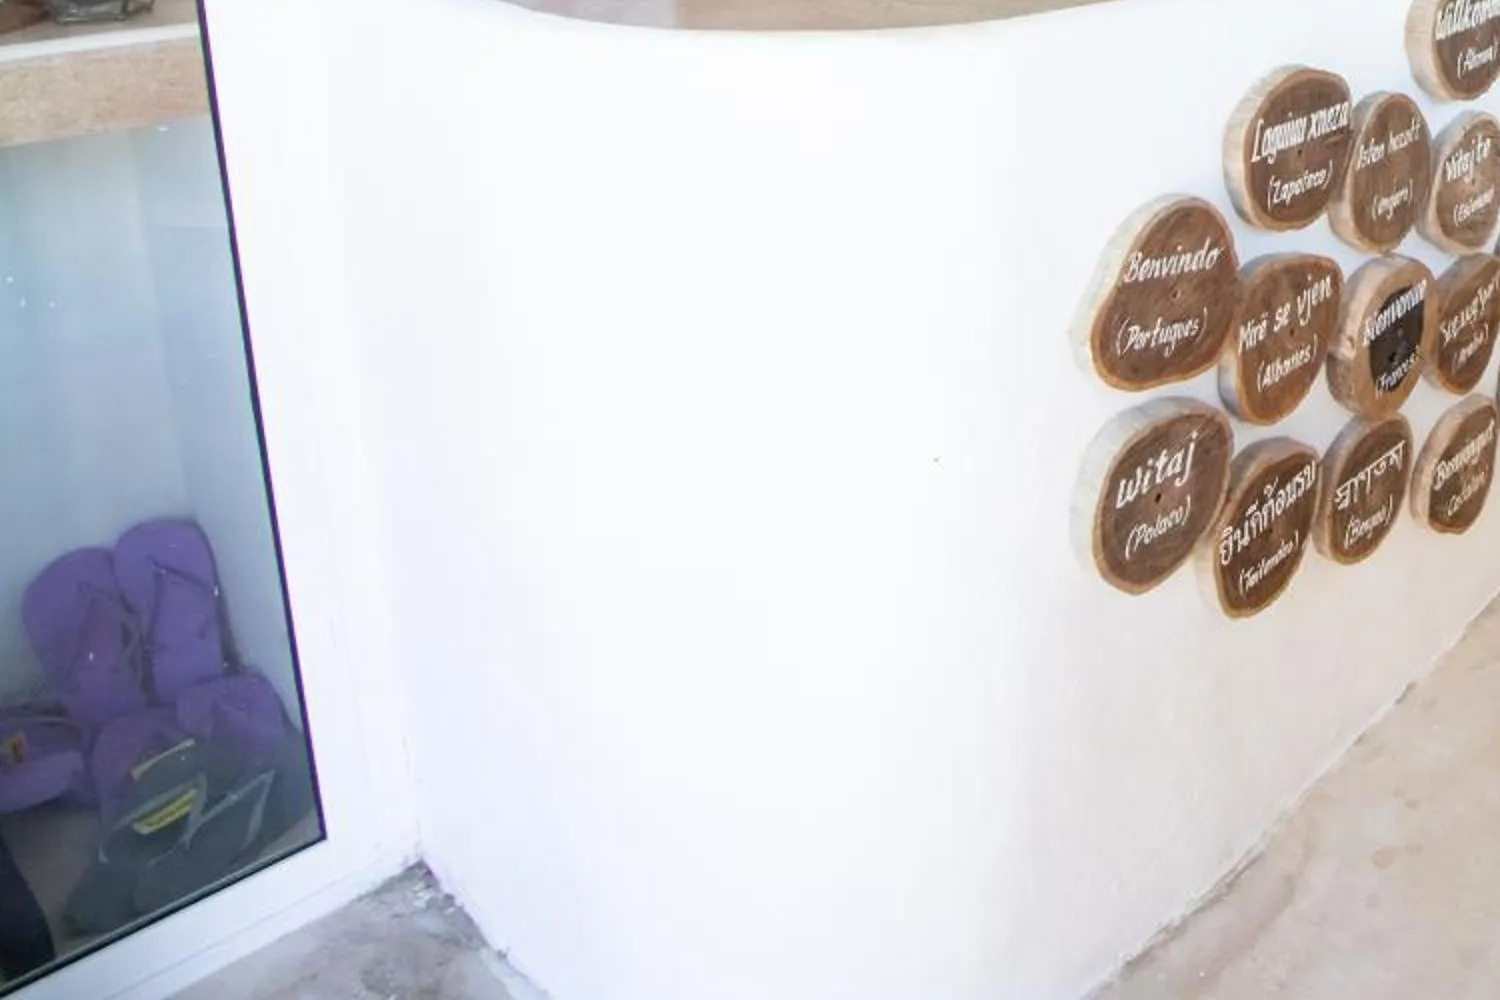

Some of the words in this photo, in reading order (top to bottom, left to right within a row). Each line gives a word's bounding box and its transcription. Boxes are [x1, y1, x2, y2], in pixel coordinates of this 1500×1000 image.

[1123, 237, 1224, 283] Benvindo
[1273, 303, 1291, 333] se
[1297, 273, 1334, 326] vjen
[1115, 429, 1198, 508] Witaj
[1125, 495, 1191, 560] (Polaco)
